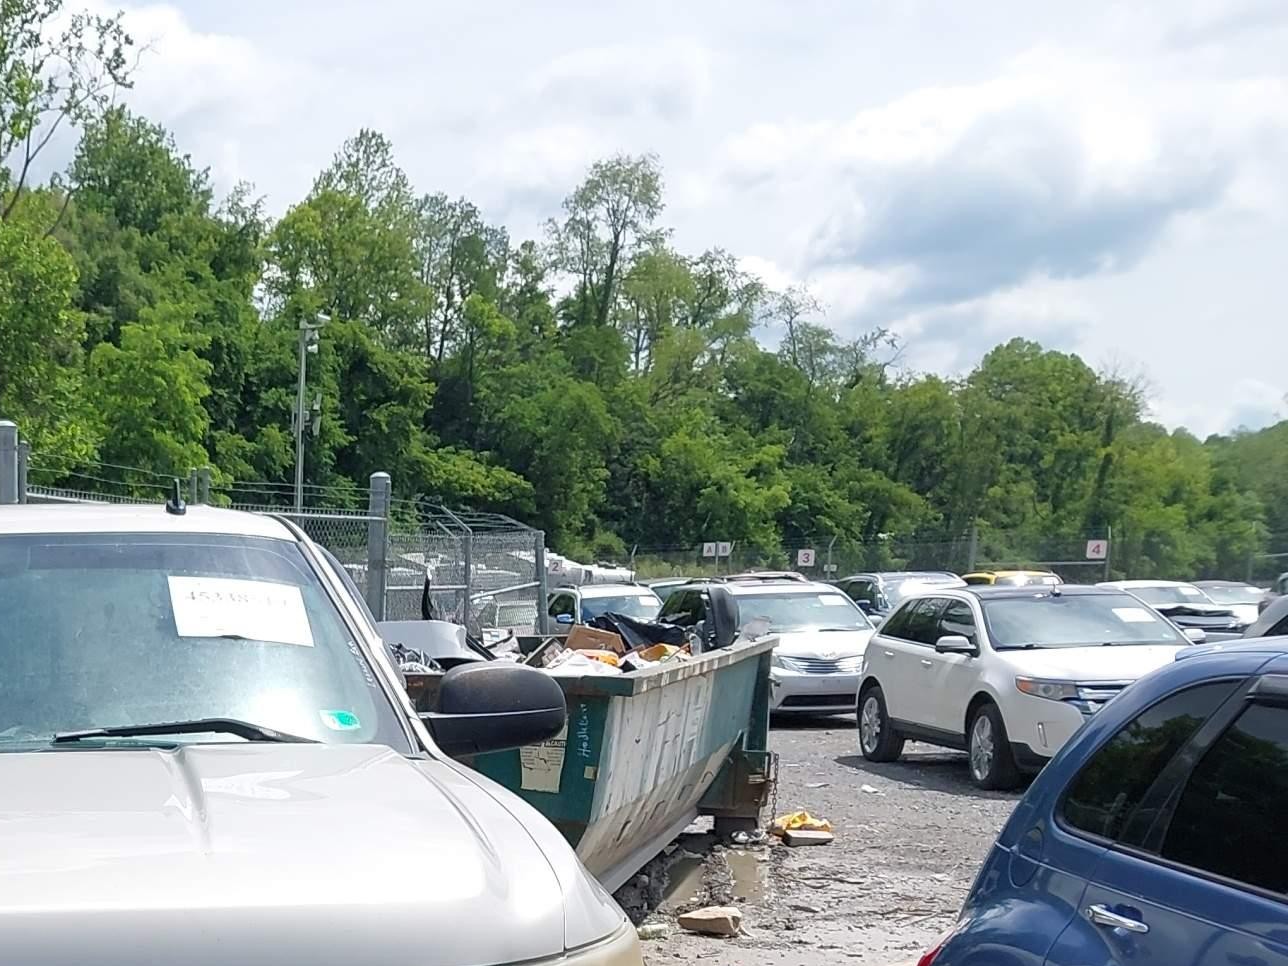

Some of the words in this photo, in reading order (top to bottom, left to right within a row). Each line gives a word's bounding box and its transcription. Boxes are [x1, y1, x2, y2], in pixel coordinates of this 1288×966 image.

[1092, 544, 1101, 555] 4
[802, 552, 810, 563] 3
[551, 561, 559, 571] 2
